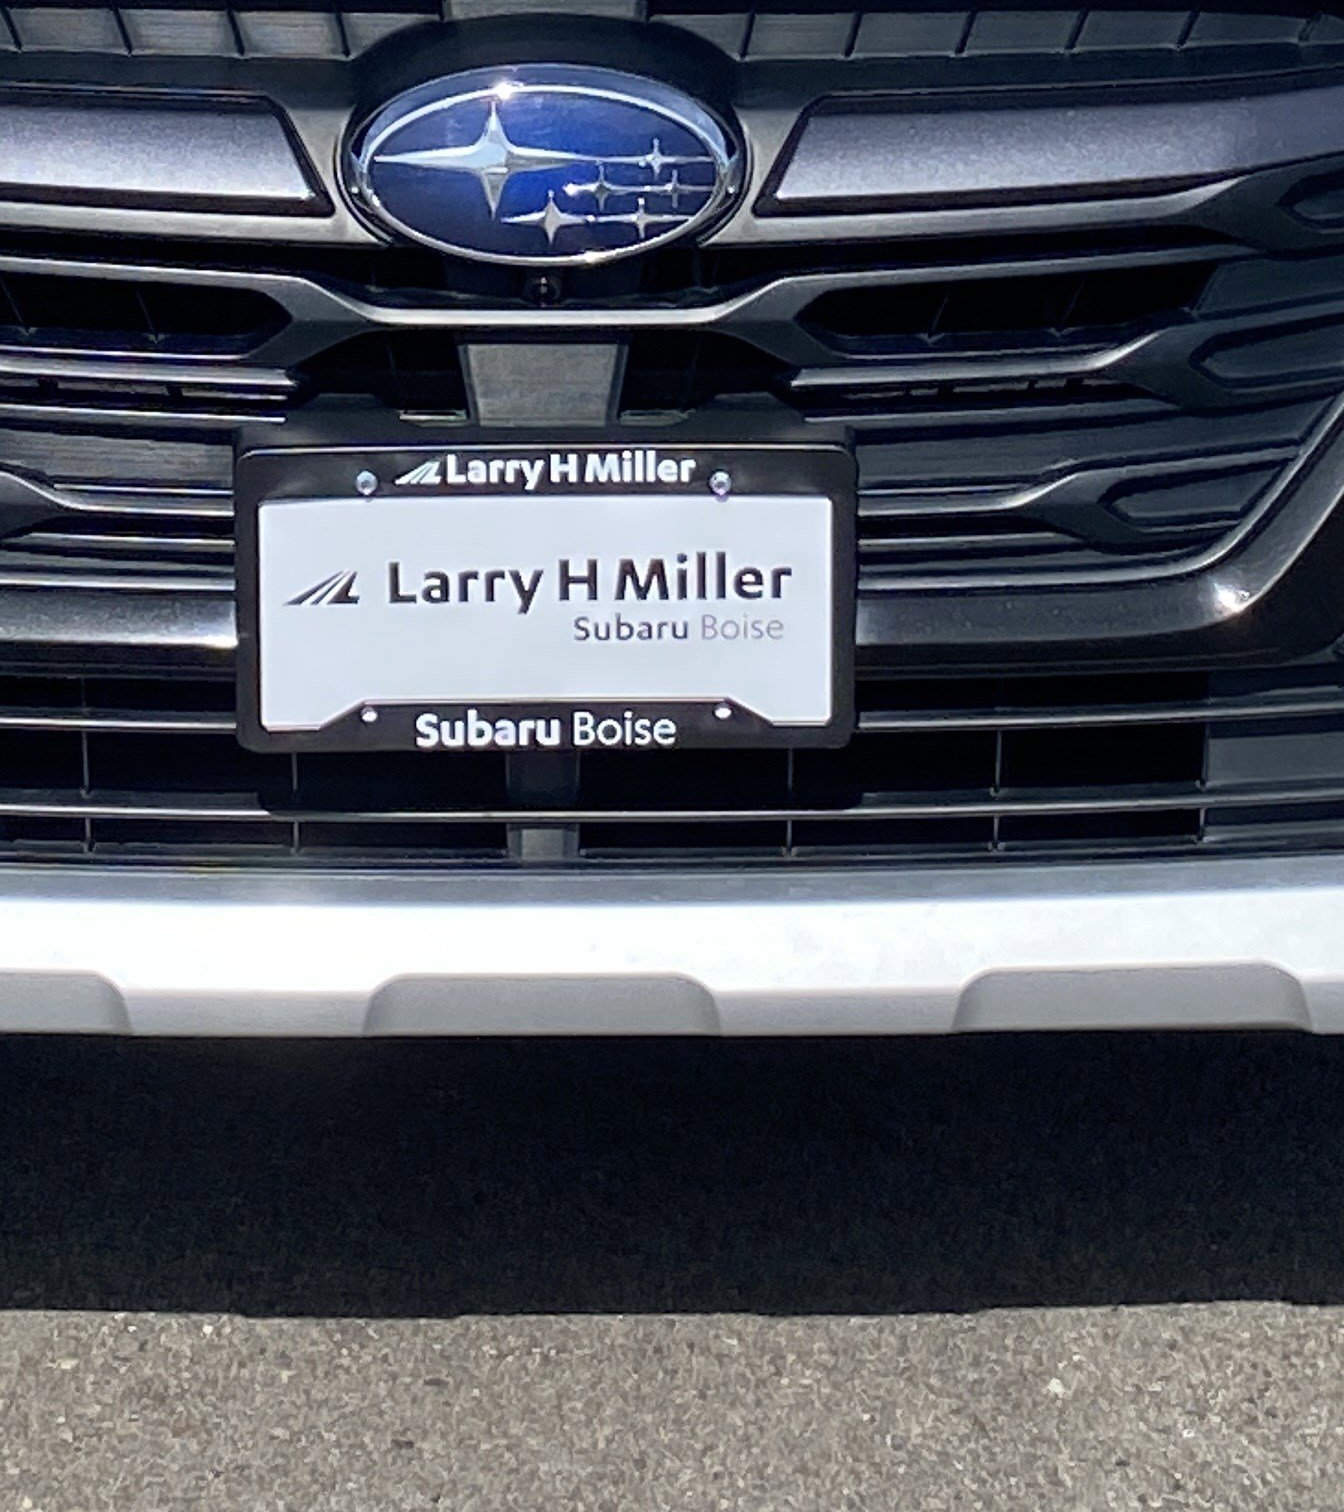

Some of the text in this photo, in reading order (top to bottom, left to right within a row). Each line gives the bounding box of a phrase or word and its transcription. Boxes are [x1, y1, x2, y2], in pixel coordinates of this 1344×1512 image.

[446, 450, 696, 490] Larry H Miller
[388, 551, 793, 614] Larry H Miller
[573, 612, 784, 641] Subaru Boise
[416, 709, 676, 747] Subaru Boise
